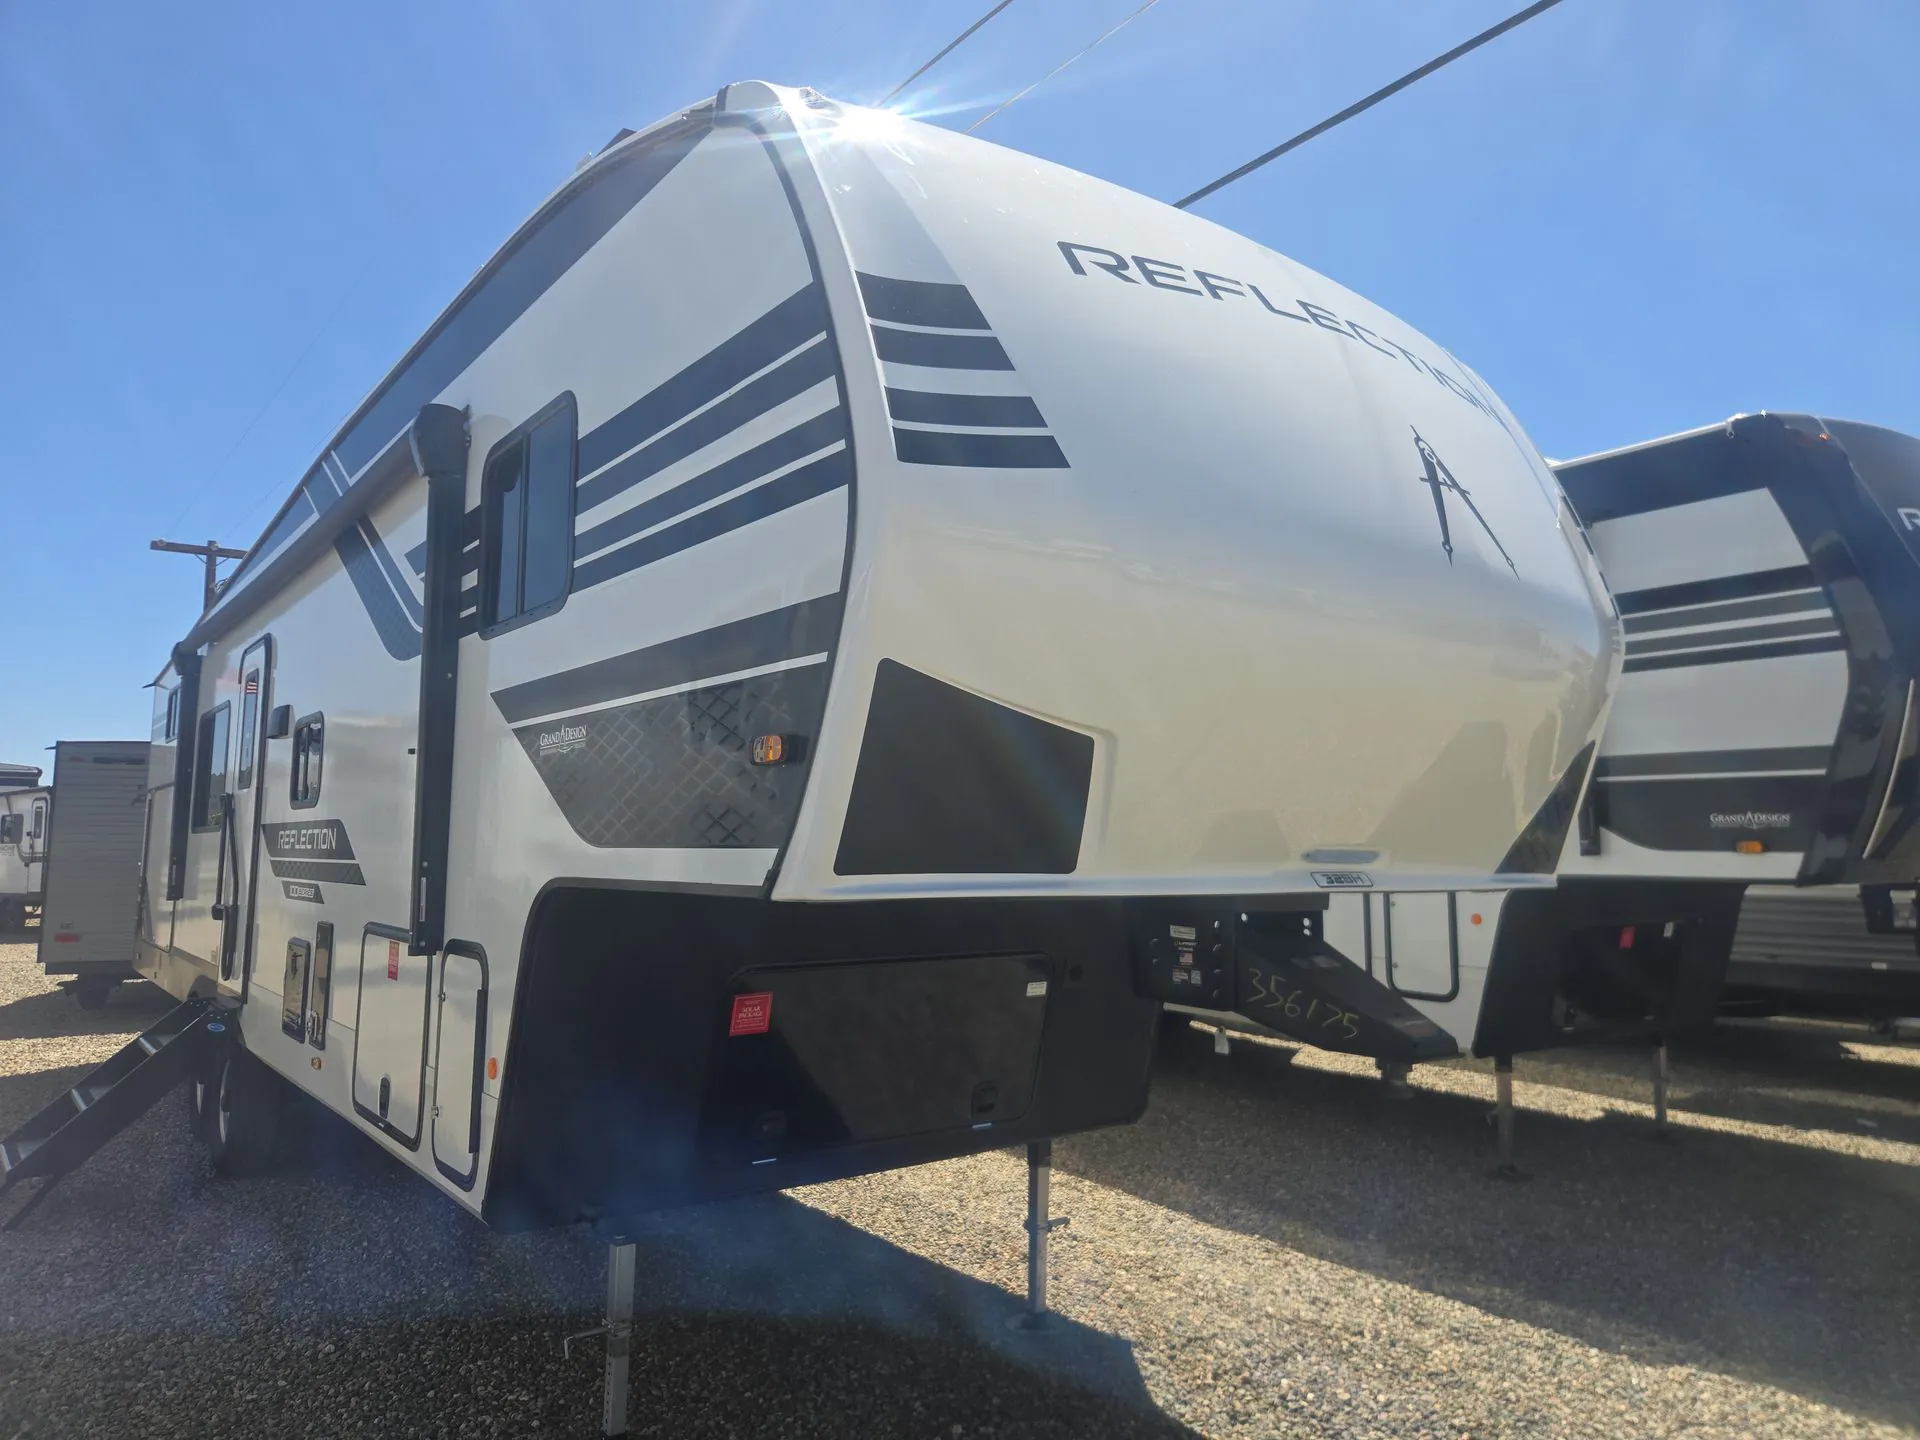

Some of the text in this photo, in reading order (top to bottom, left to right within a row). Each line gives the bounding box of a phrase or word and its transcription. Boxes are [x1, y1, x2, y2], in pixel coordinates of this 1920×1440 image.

[1056, 240, 1501, 422] REFLECTION
[540, 724, 588, 746] GRAND DESIGN
[1709, 812, 1792, 825] GRAND DESIGN
[277, 827, 337, 850] REFLECTION
[1246, 966, 1360, 1039] 356175
